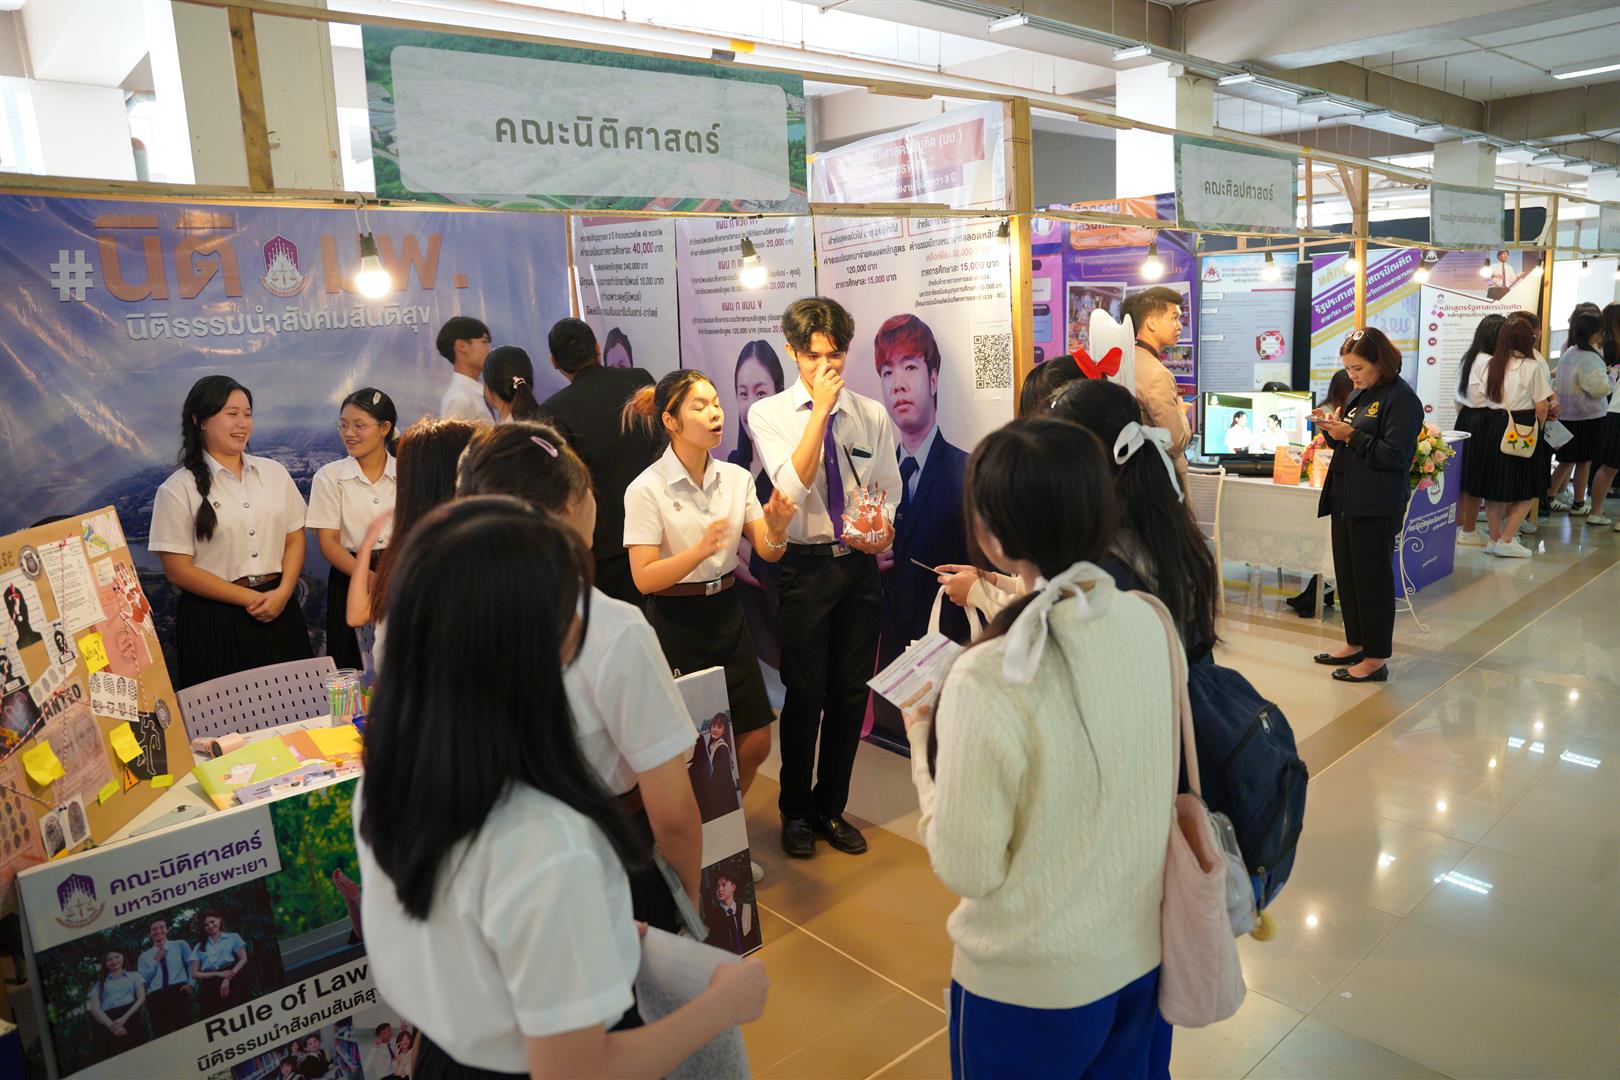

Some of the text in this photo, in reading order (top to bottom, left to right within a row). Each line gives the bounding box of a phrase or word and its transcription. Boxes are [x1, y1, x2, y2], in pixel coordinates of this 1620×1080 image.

[495, 115, 720, 154] คณะนิติศาสตร์
[1204, 179, 1274, 201] คณะศิลปศาสตร์
[50, 213, 242, 302] #นิติ
[867, 275, 885, 285] 15,000
[960, 262, 984, 272] 15,000
[126, 303, 431, 340] นิติธรรมนำสังคมสันติสุข
[109, 829, 262, 895] คณะนิติศาสตร์
[113, 856, 268, 917] มหาวิทยาลัยพะเยา
[205, 963, 368, 1043] Rule of Law
[197, 986, 380, 1072] นิติธรรมนำสังคมสันติสุ
